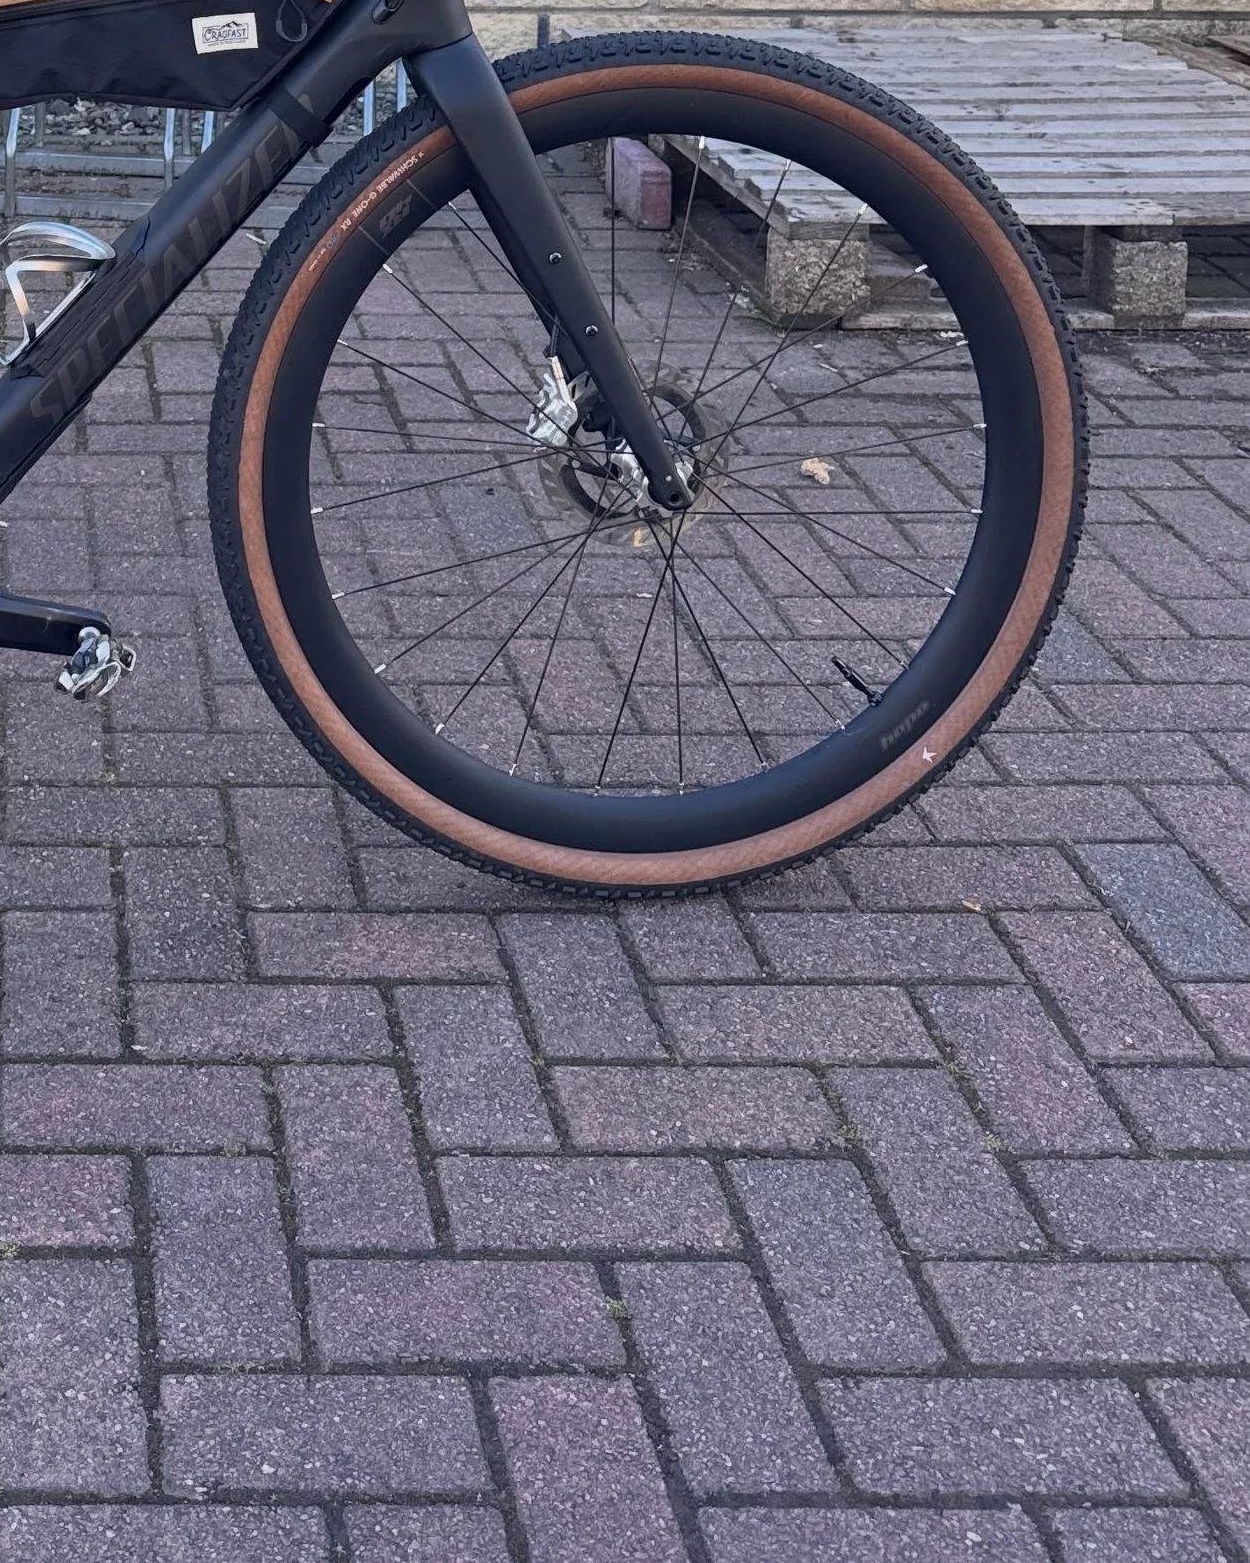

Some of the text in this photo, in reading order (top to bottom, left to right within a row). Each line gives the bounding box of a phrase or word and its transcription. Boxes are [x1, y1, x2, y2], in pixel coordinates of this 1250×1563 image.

[204, 28, 246, 41] CRAGFAST
[376, 155, 418, 193] SCHWALBE
[351, 191, 377, 218] G-ONE
[340, 218, 352, 231] RX
